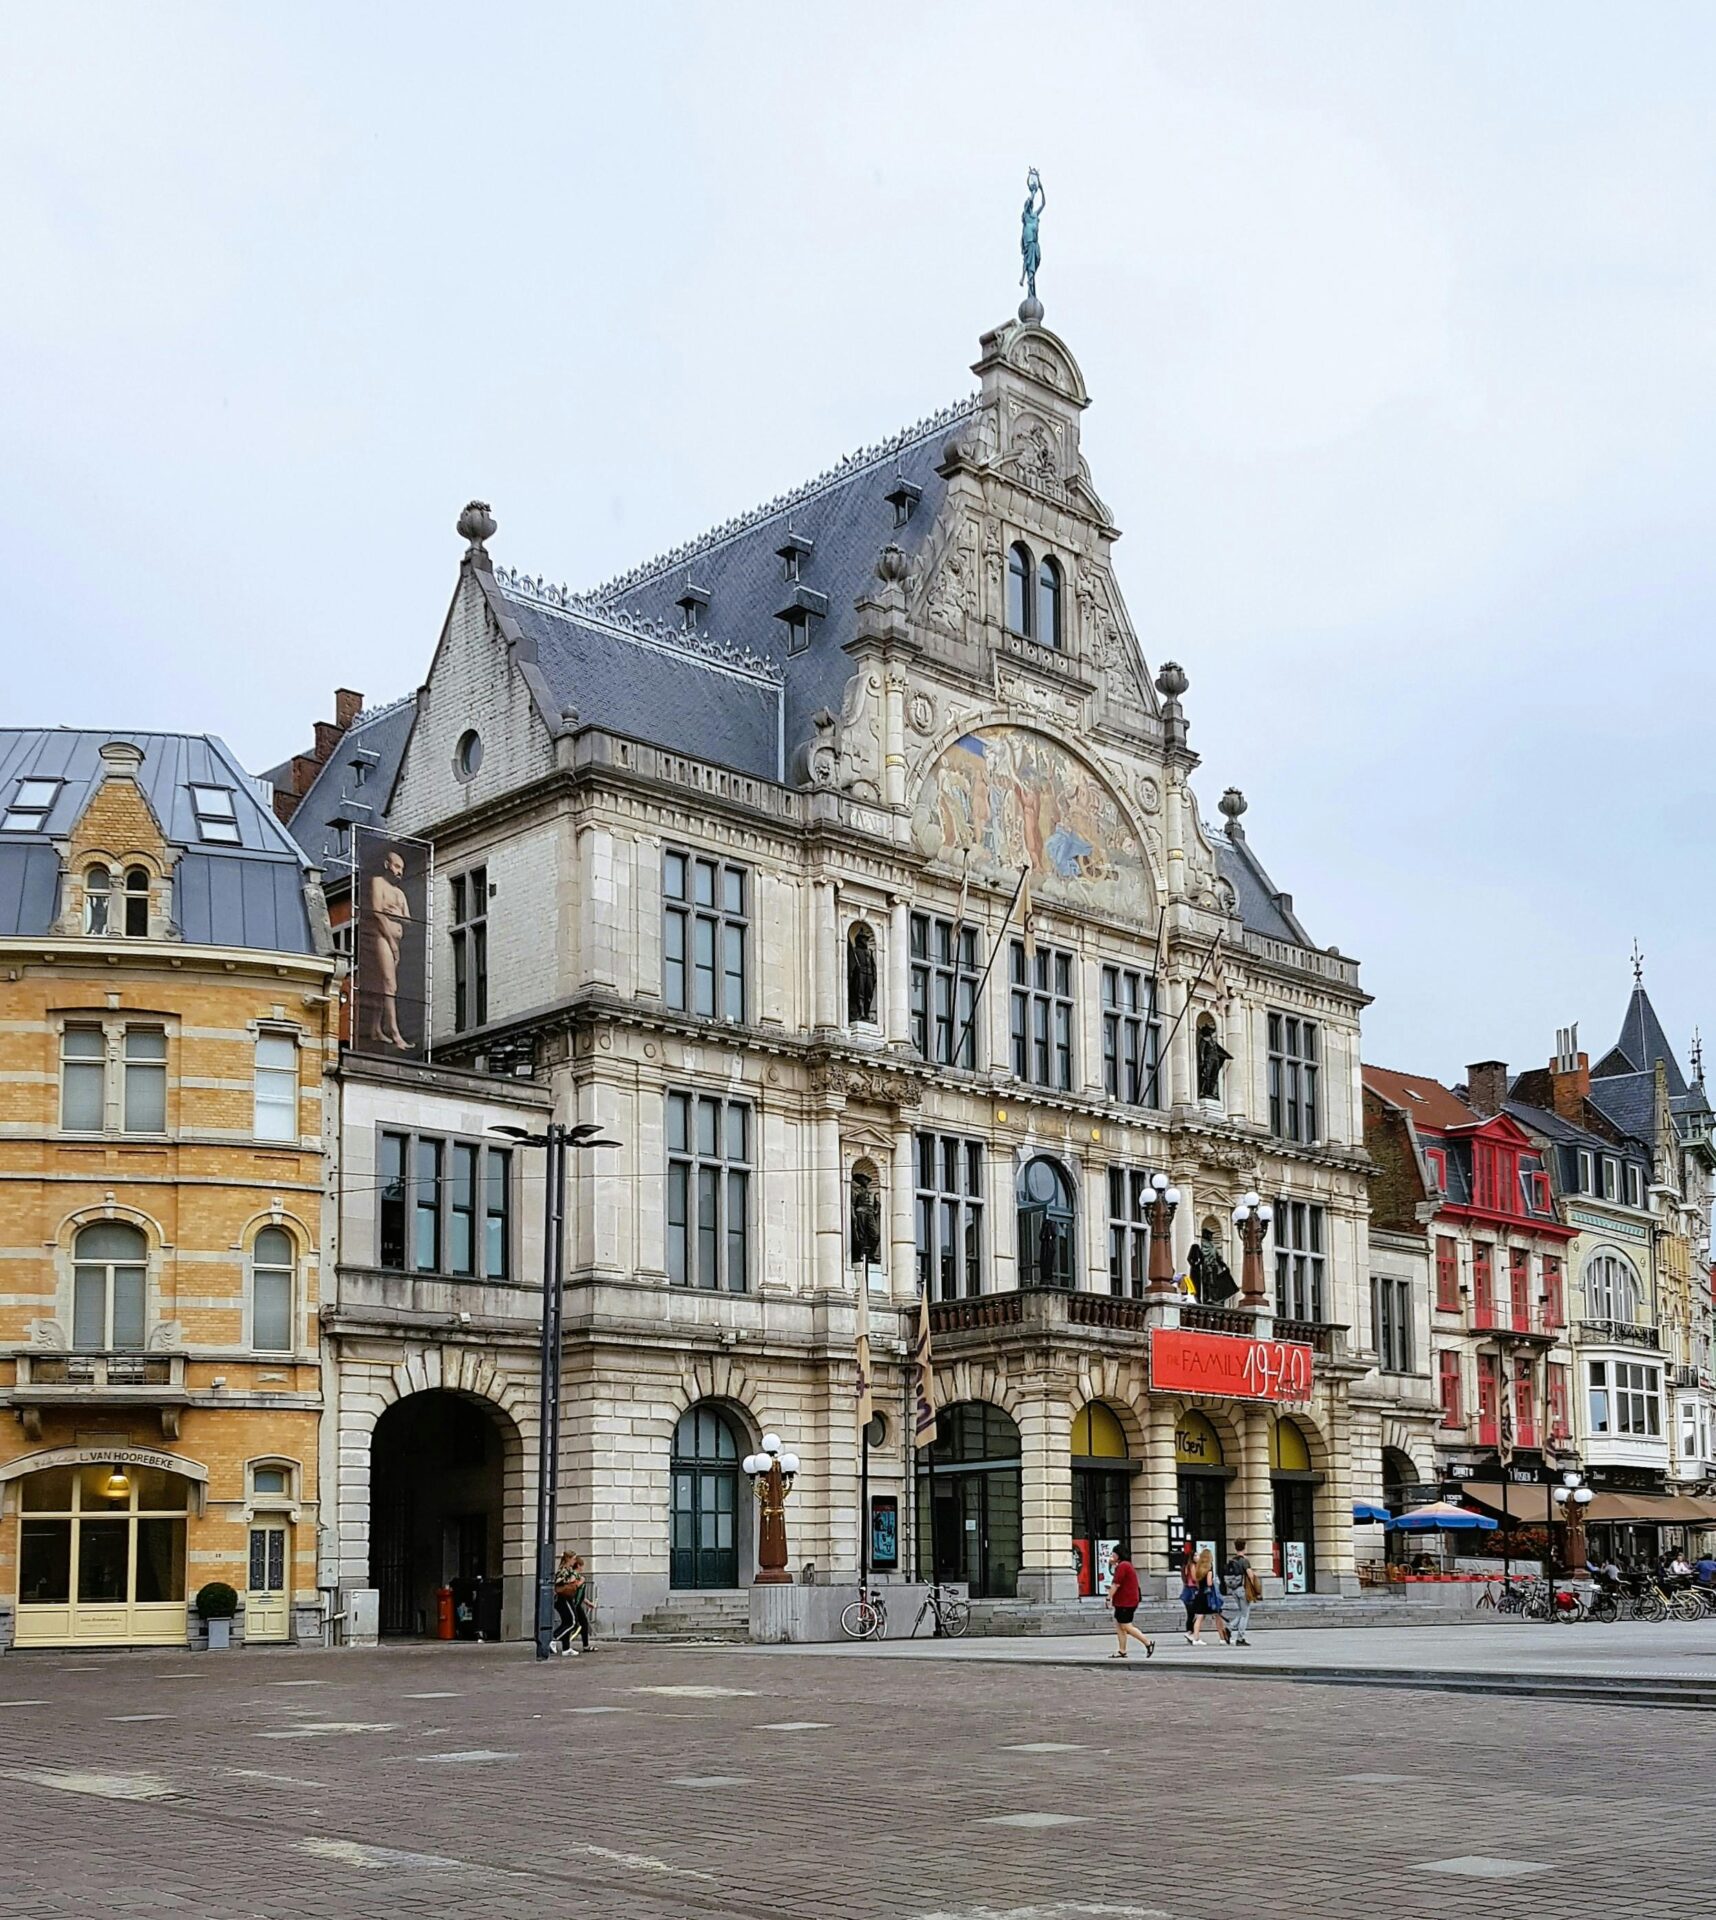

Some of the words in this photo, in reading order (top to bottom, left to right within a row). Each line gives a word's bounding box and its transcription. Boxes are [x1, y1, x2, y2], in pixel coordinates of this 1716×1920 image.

[1182, 1349, 1248, 1378] FAMILY
[1242, 1344, 1304, 1397] 19-20
[90, 1452, 112, 1460] VAN
[114, 1452, 174, 1469] HOOREBEKE
